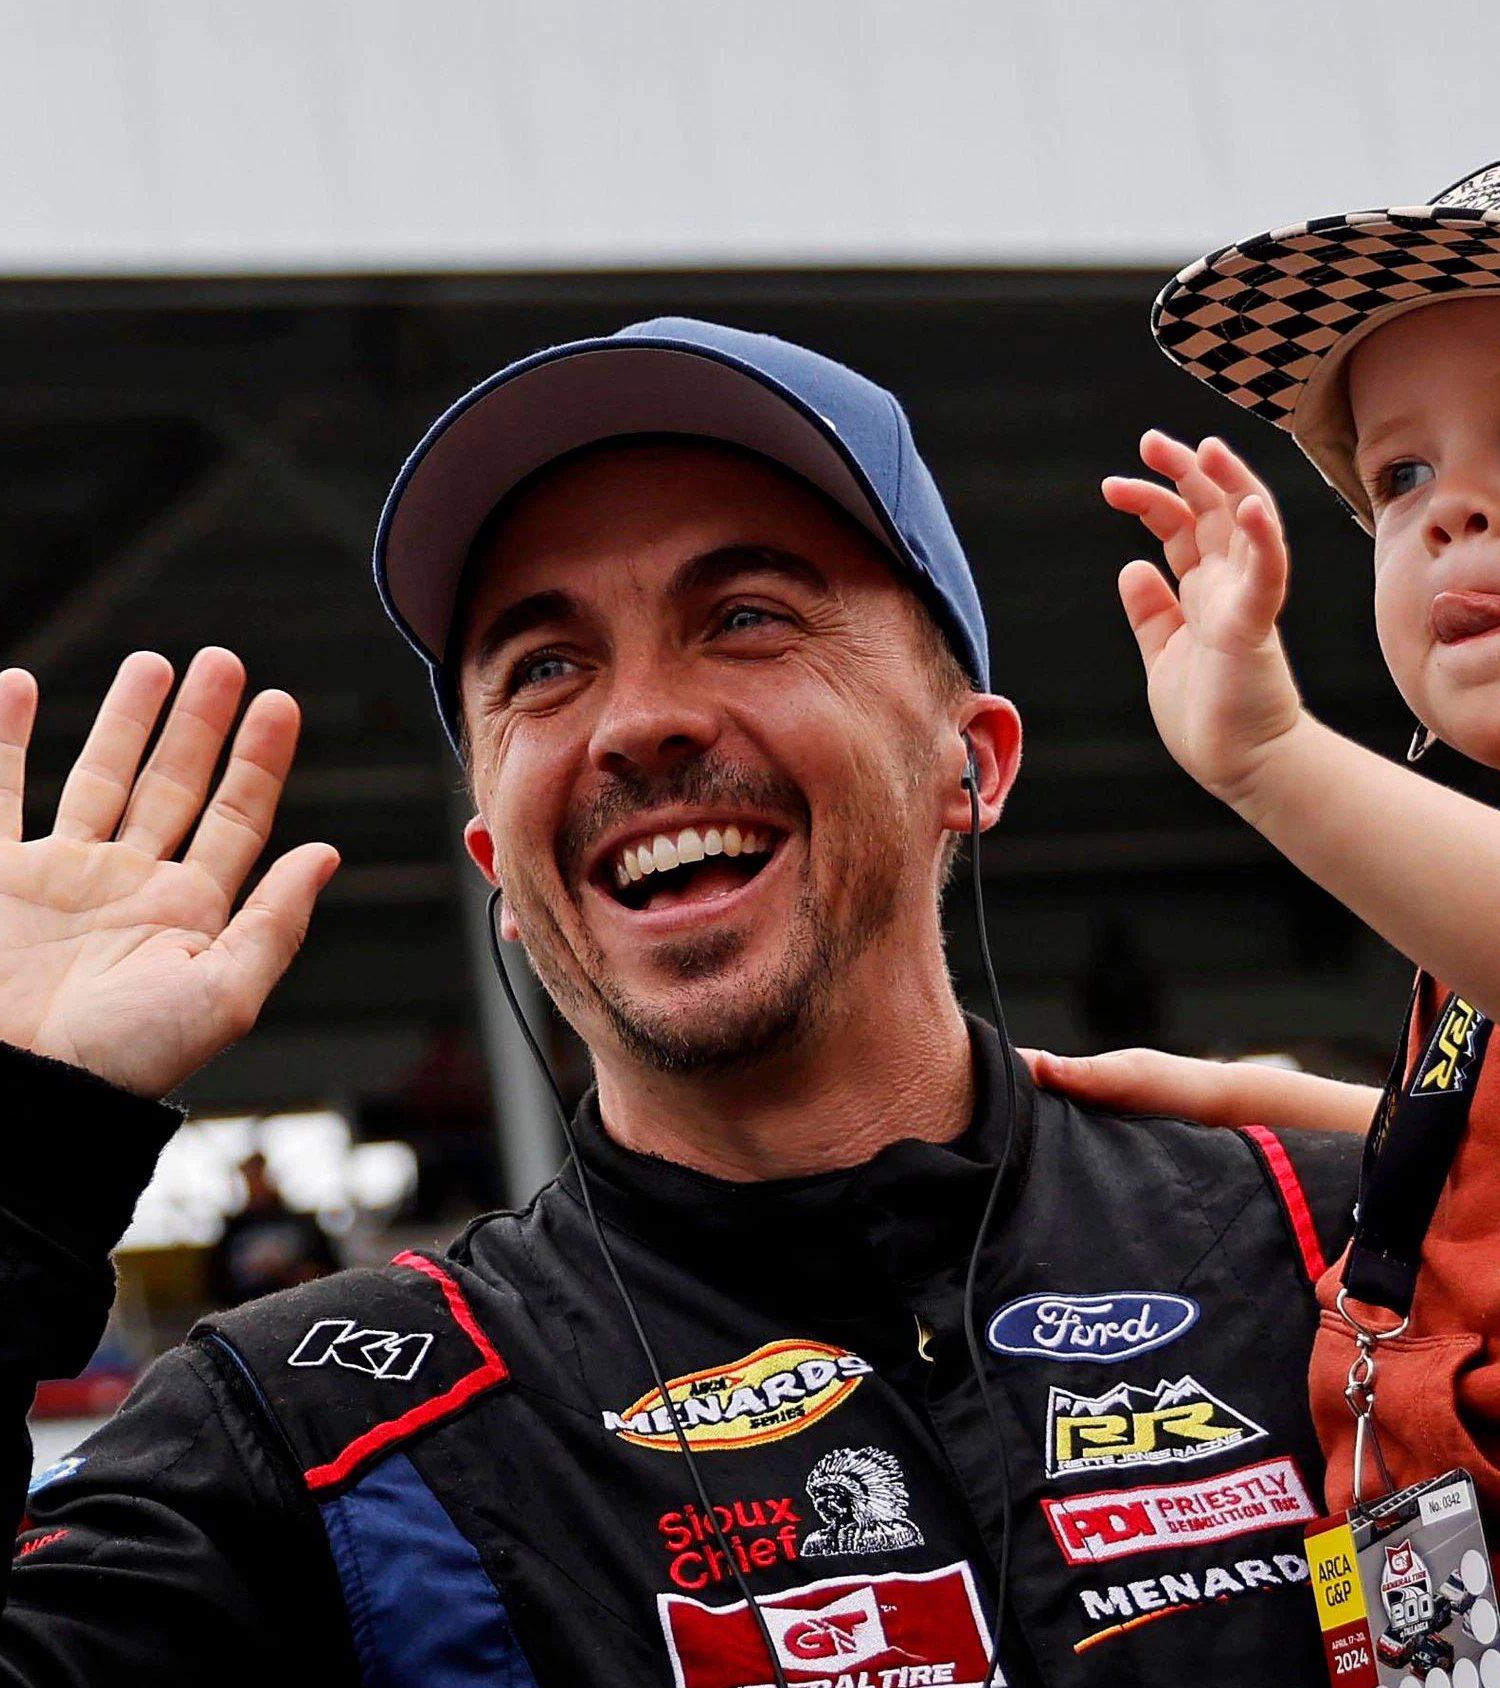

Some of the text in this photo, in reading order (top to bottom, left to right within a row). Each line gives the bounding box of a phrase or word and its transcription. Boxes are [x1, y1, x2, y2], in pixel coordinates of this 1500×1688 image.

[1032, 1302, 1159, 1347] Ford
[288, 1319, 434, 1380] K1
[601, 1356, 874, 1434] MENARDS
[1155, 1471, 1288, 1518] PRIESTLY
[1166, 1496, 1300, 1533] DEMOLITION INC
[1442, 1491, 1462, 1511] 0342
[658, 1498, 803, 1551] Sioux
[1058, 1500, 1157, 1549] PDI
[670, 1525, 797, 1589] Chief
[1318, 1553, 1353, 1584] ARCA
[1079, 1554, 1309, 1621] MENARD
[1325, 1580, 1353, 1607] G&P
[1390, 1593, 1435, 1630] 200
[1334, 1646, 1370, 1675] 2024
